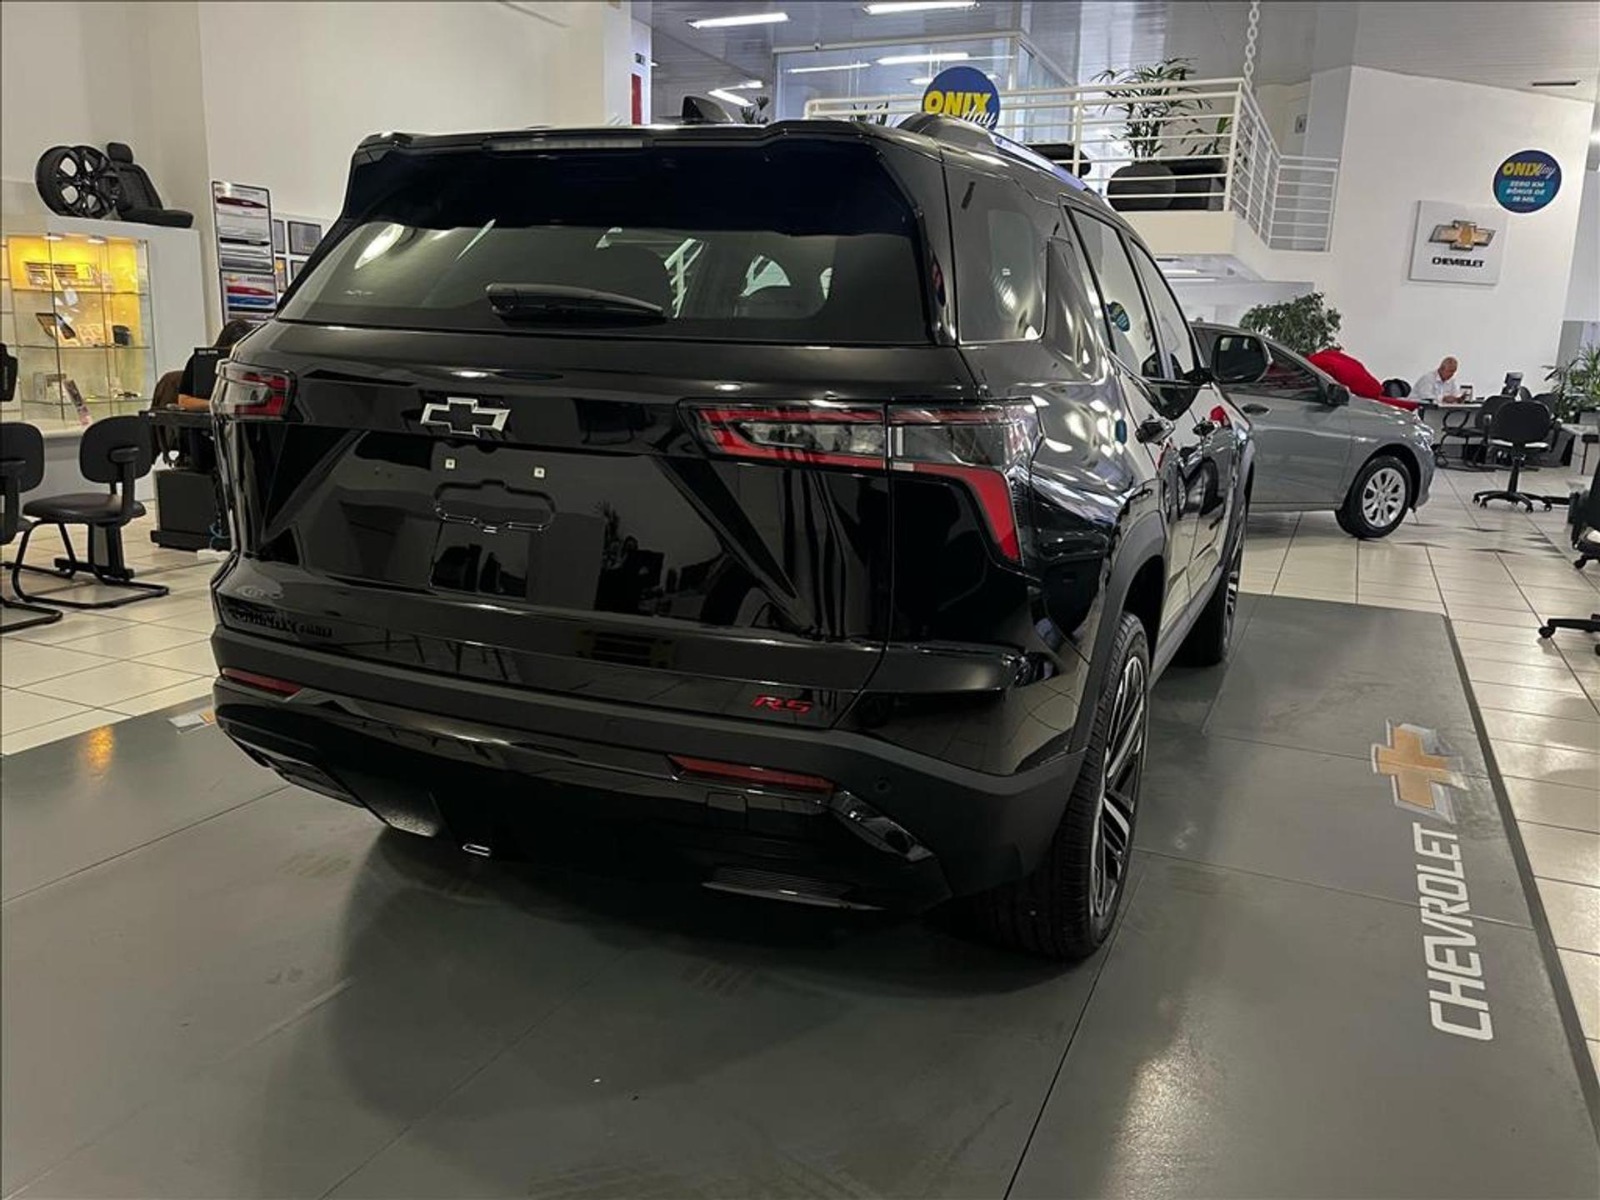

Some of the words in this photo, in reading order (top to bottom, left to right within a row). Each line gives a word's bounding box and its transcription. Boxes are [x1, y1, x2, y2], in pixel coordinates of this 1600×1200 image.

[924, 90, 992, 118] ONIX
[1502, 162, 1543, 176] ONIX
[1432, 257, 1484, 268] CHEVROLET
[751, 695, 813, 714] RS
[1412, 822, 1494, 1041] CHEVROLET
